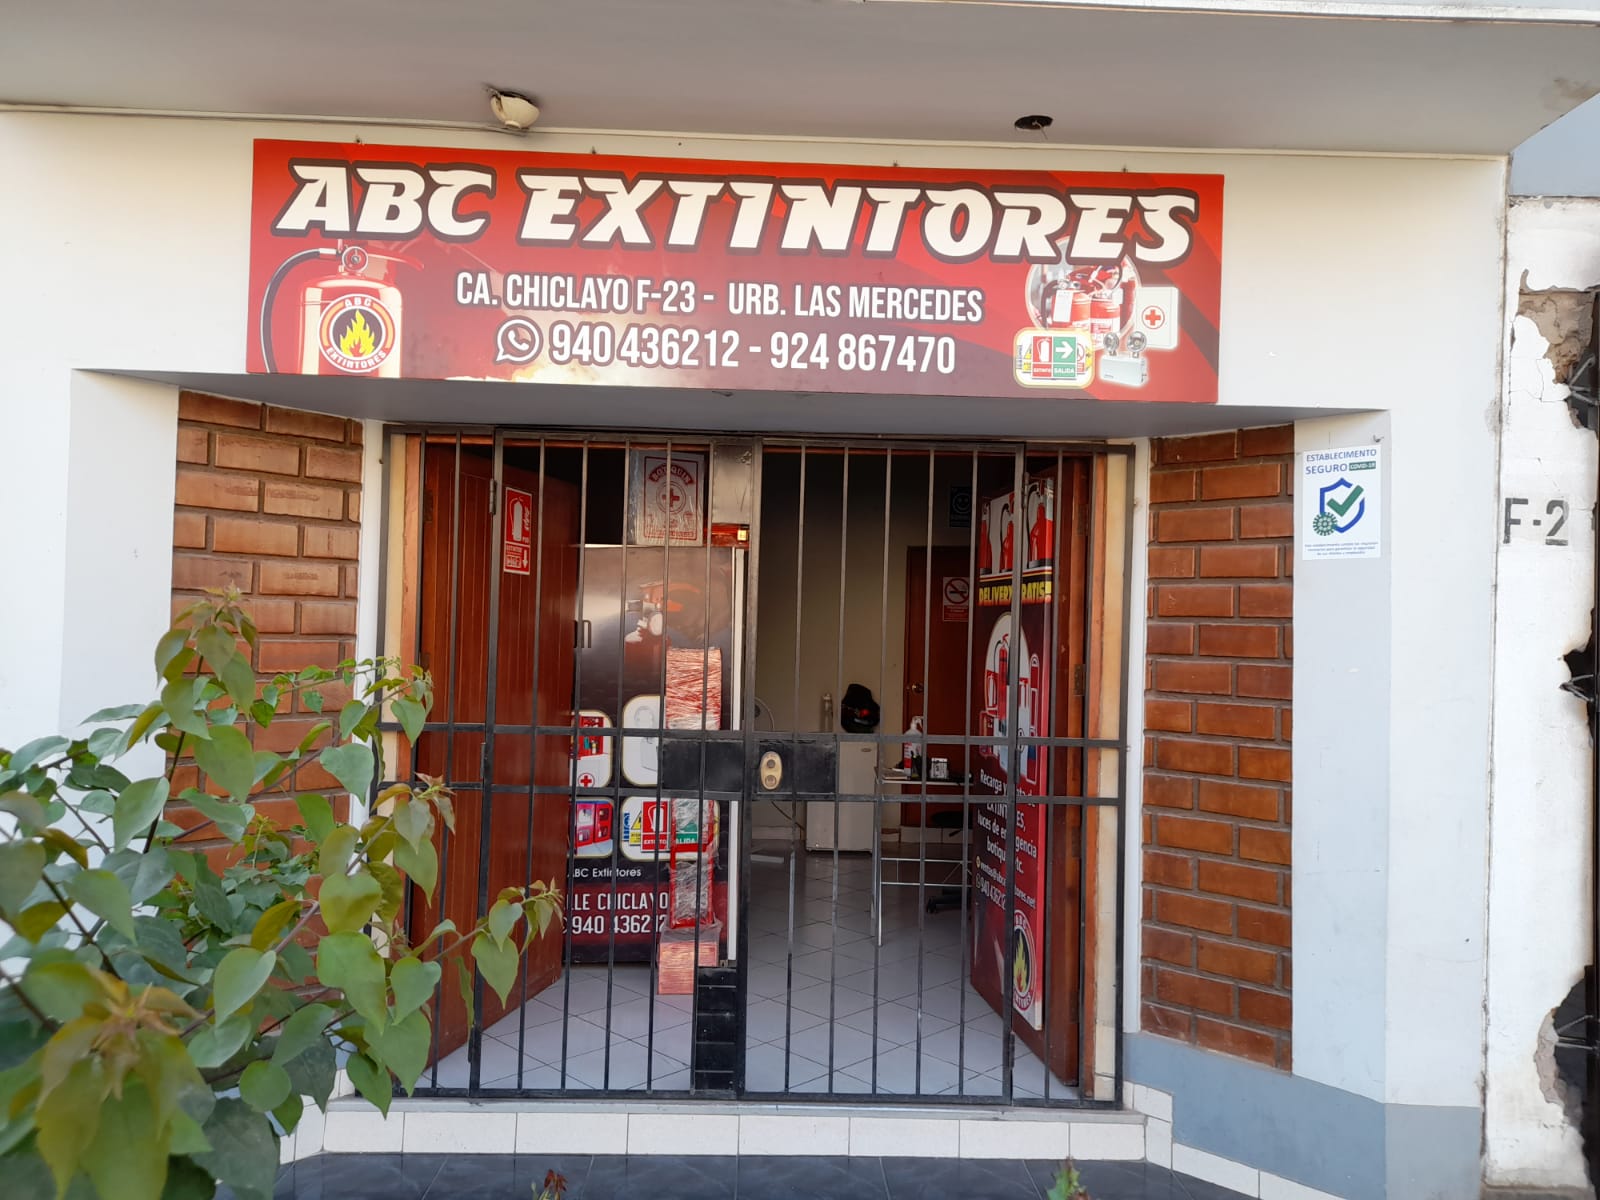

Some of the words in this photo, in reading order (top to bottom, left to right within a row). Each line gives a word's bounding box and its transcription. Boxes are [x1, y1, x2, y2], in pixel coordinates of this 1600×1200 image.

[273, 163, 495, 239] ABC
[517, 173, 1197, 263] EXTINTORES
[344, 296, 373, 309] ABC
[456, 270, 499, 306] CA.
[506, 273, 630, 312] CHICLAYO
[637, 278, 696, 315] F-23
[728, 282, 787, 316] URB.
[793, 285, 842, 319] LAS
[848, 287, 984, 323] MERCEDES
[552, 323, 612, 365] 940
[620, 326, 740, 369] 436212
[770, 331, 830, 371] 924
[837, 332, 957, 375] 867470
[650, 464, 693, 484] BOTQUIN
[1305, 463, 1348, 475] SEGURO
[572, 914, 605, 935] 940
